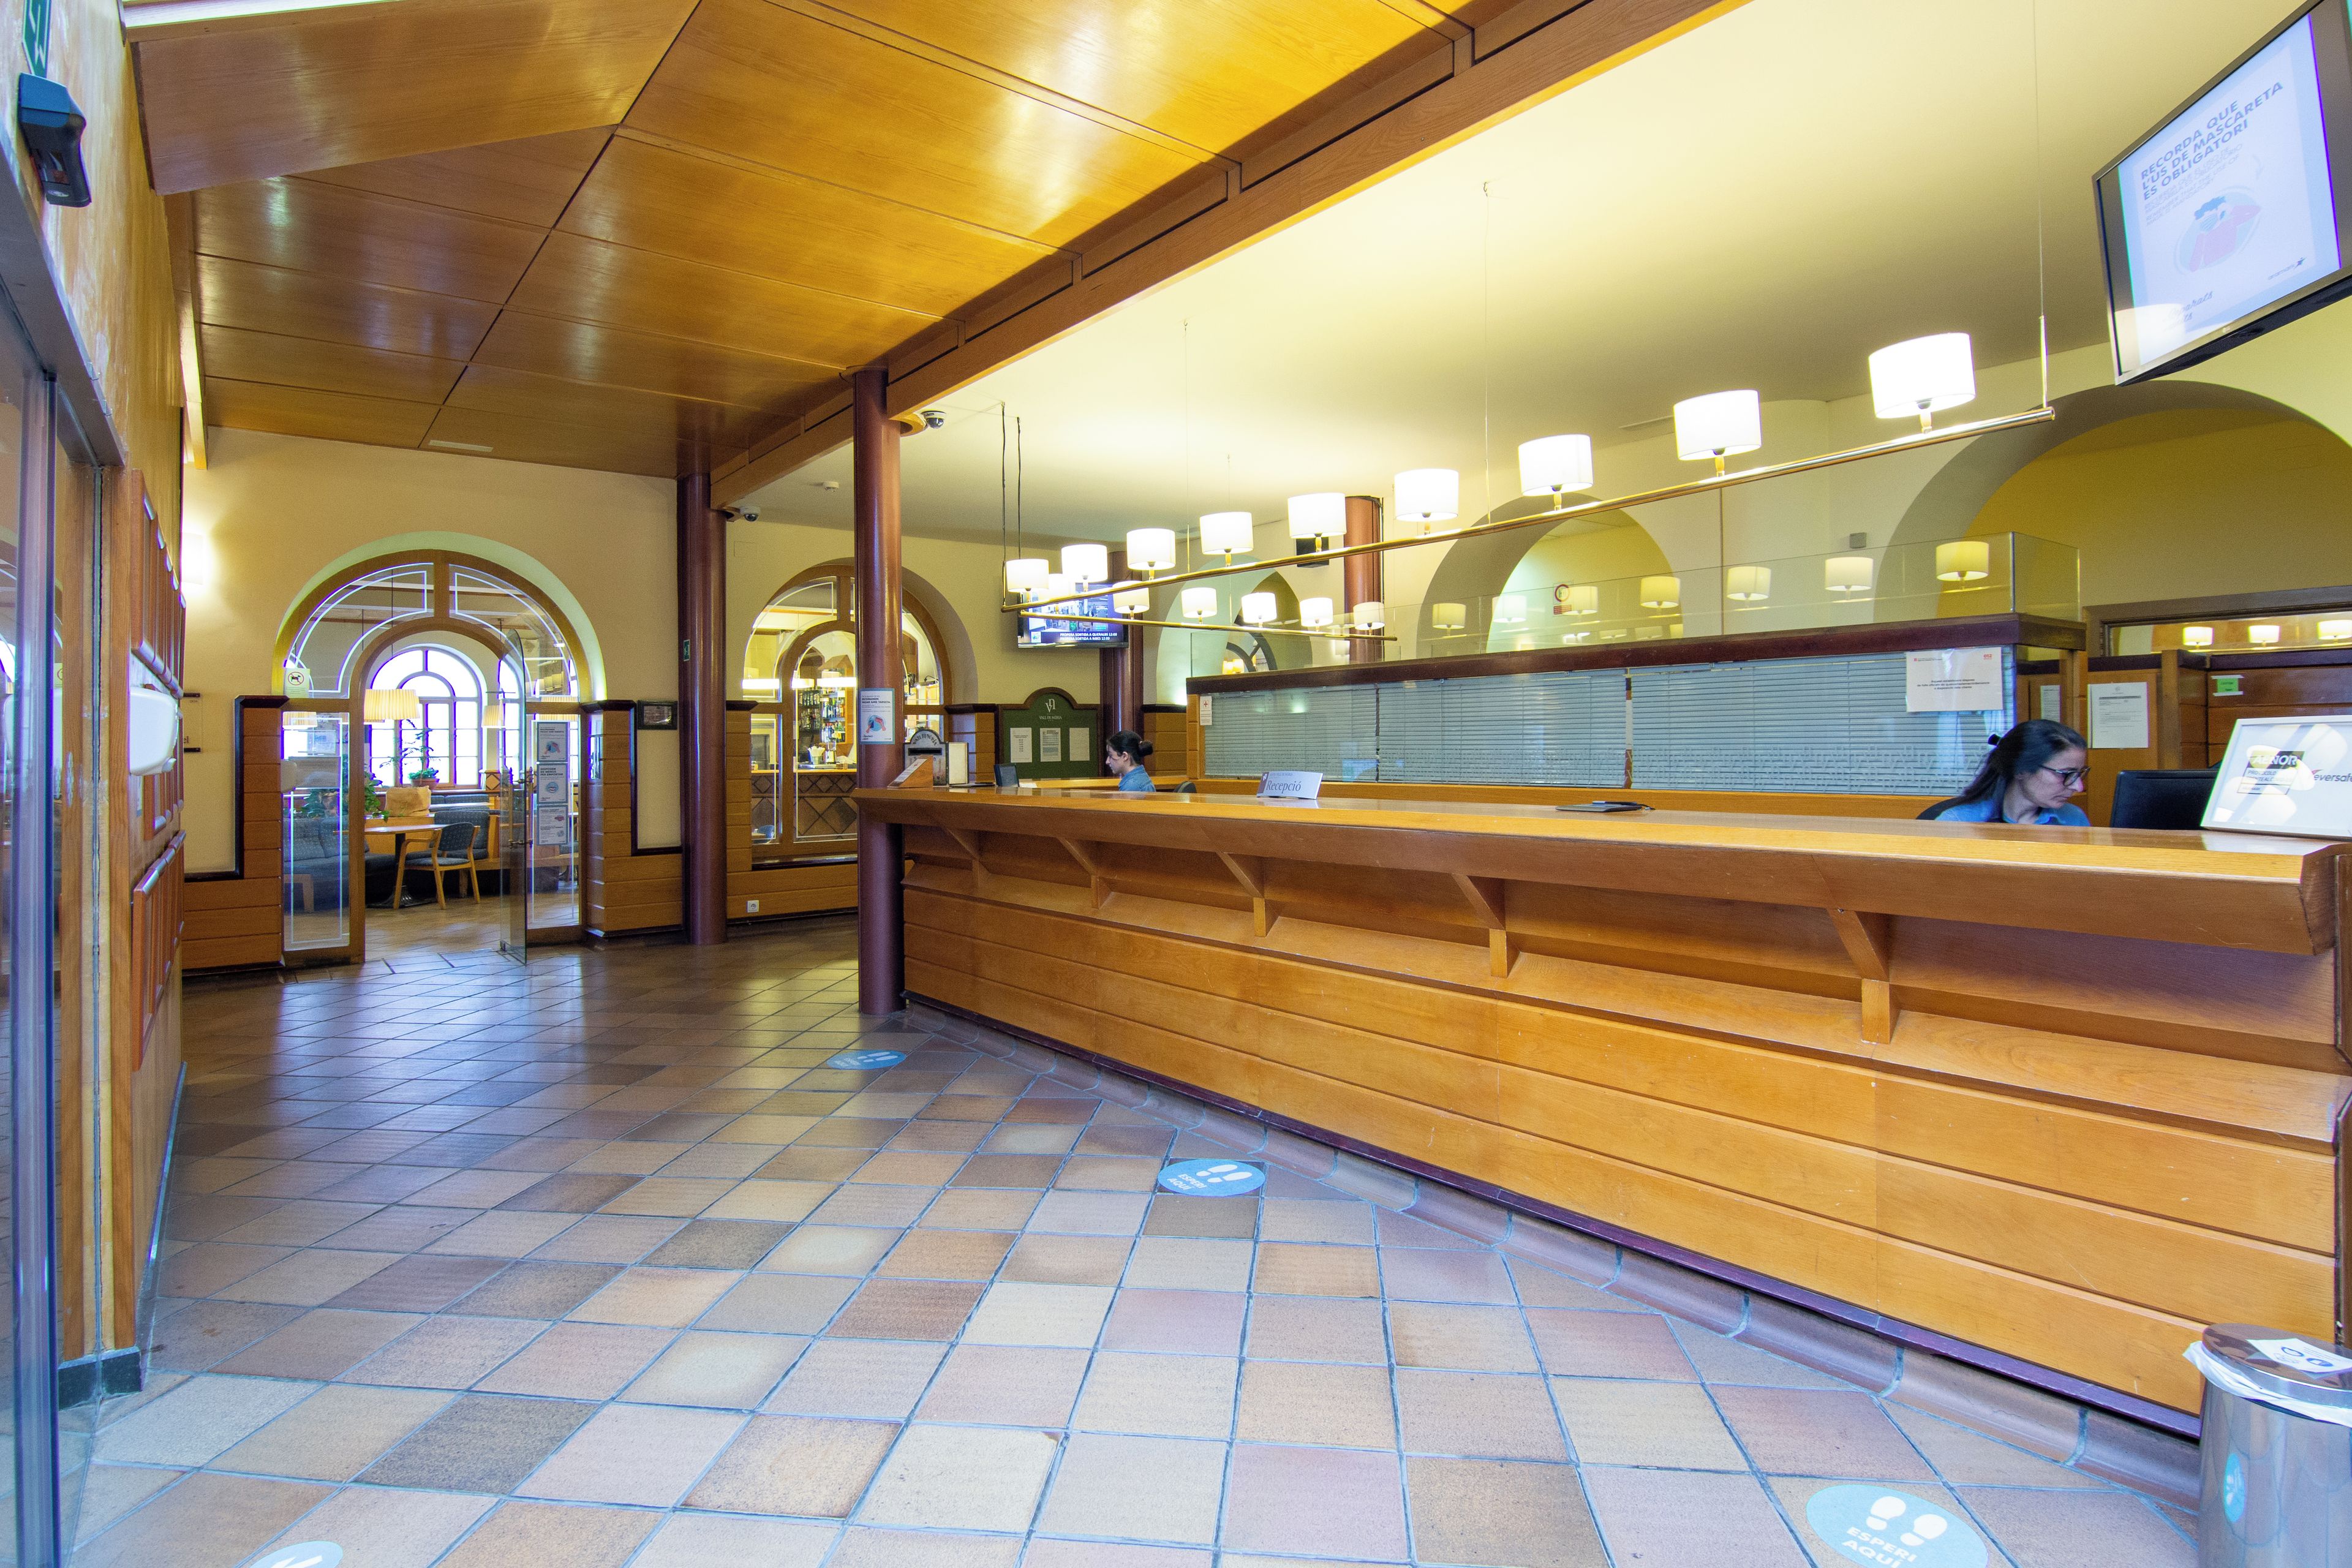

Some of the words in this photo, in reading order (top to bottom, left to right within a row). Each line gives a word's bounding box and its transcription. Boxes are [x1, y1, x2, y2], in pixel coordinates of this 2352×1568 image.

[2141, 129, 2203, 180] RECORDA
[2207, 100, 2239, 130] QUE
[2143, 166, 2168, 190] L'US
[2172, 150, 2190, 168] DE
[2193, 81, 2283, 153] MASCARETA
[2162, 119, 2248, 187] OBLIGATORI
[1266, 780, 1302, 794] Recepció
[1178, 1174, 1207, 1188] ESPERI
[1847, 1526, 1917, 1562] ESPERI
